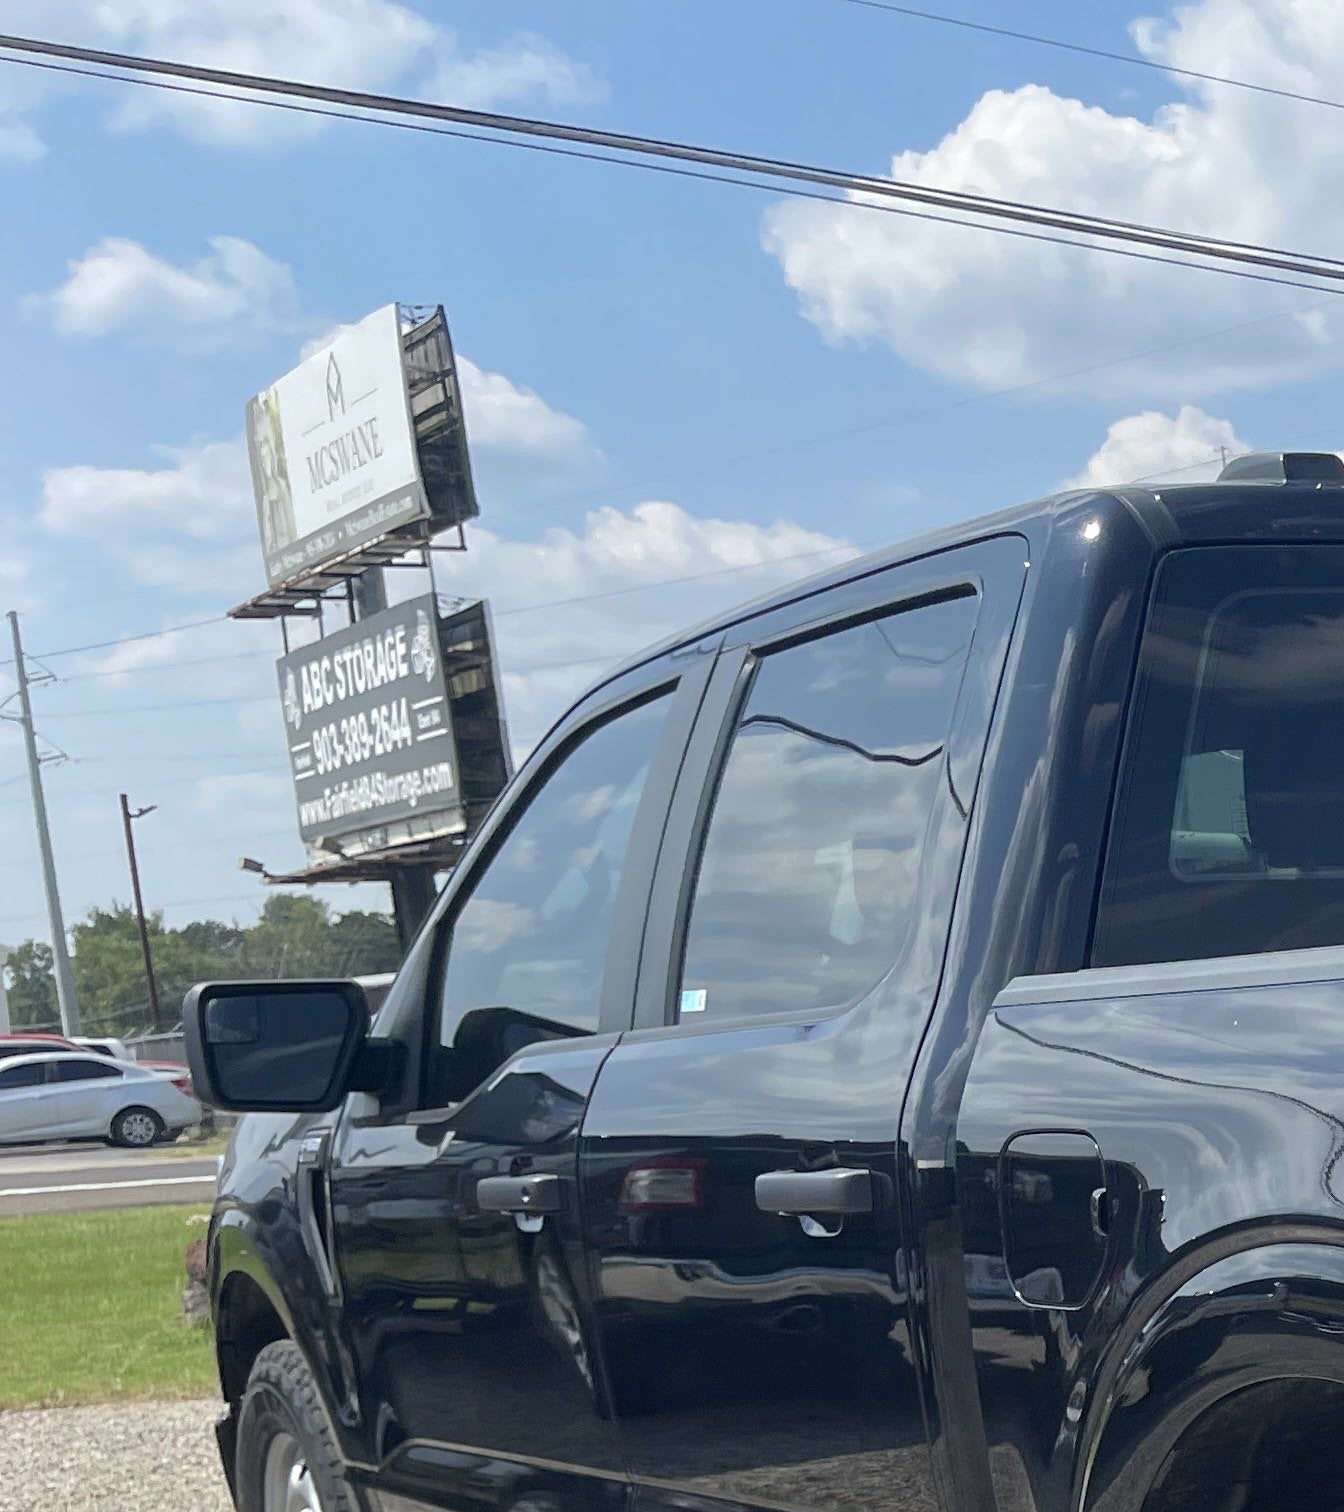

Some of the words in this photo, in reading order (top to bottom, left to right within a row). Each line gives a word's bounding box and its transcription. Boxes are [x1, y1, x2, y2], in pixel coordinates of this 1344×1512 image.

[306, 416, 383, 494] MCSWANE
[301, 656, 334, 715] ABC
[333, 624, 409, 701] STORAGE
[312, 697, 412, 775] 903-389-2644
